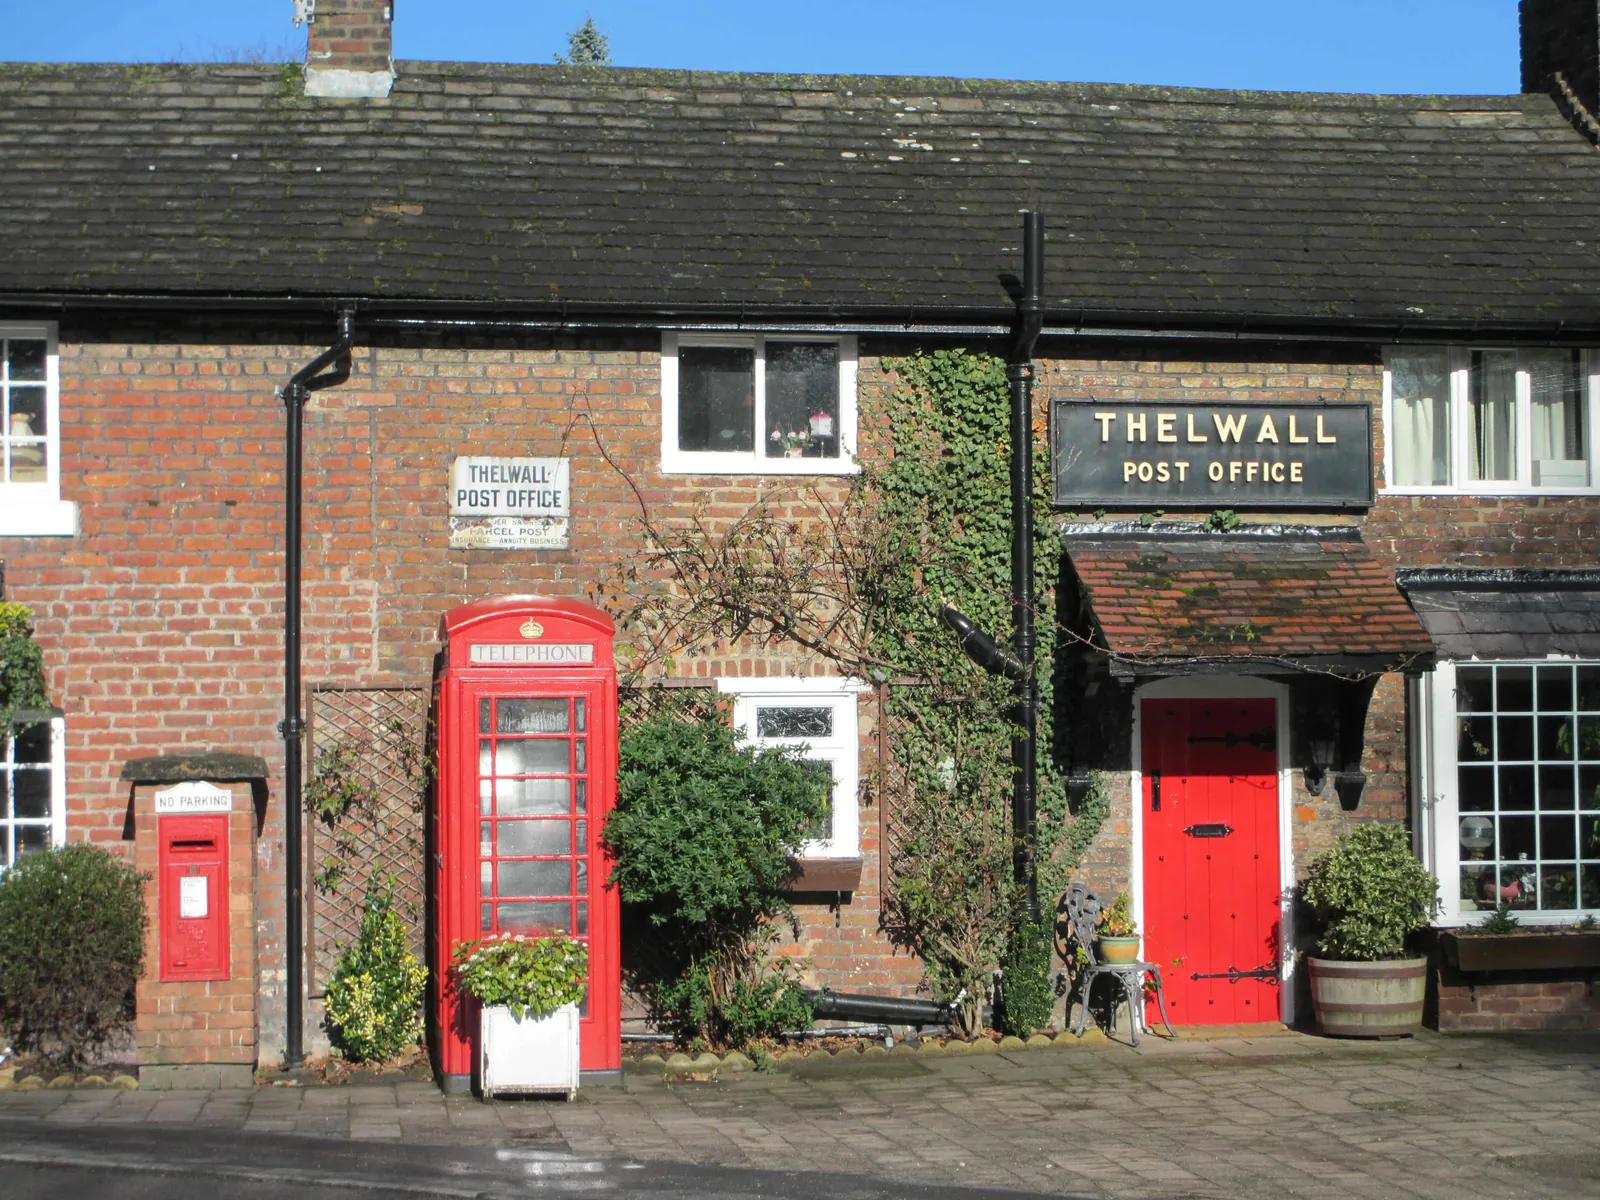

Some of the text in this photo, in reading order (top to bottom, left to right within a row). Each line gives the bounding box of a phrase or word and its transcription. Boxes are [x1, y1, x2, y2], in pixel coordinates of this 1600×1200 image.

[1094, 412, 1337, 444] THELWALL
[468, 465, 550, 483] THELWALL
[1123, 462, 1304, 483] POST OFFICE
[457, 489, 562, 508] POST OFFICE
[469, 527, 550, 536] PARCEL POST
[529, 537, 564, 545] BUSINESS
[475, 645, 589, 661] TELEPHONE
[159, 795, 228, 807] NO PARKING
